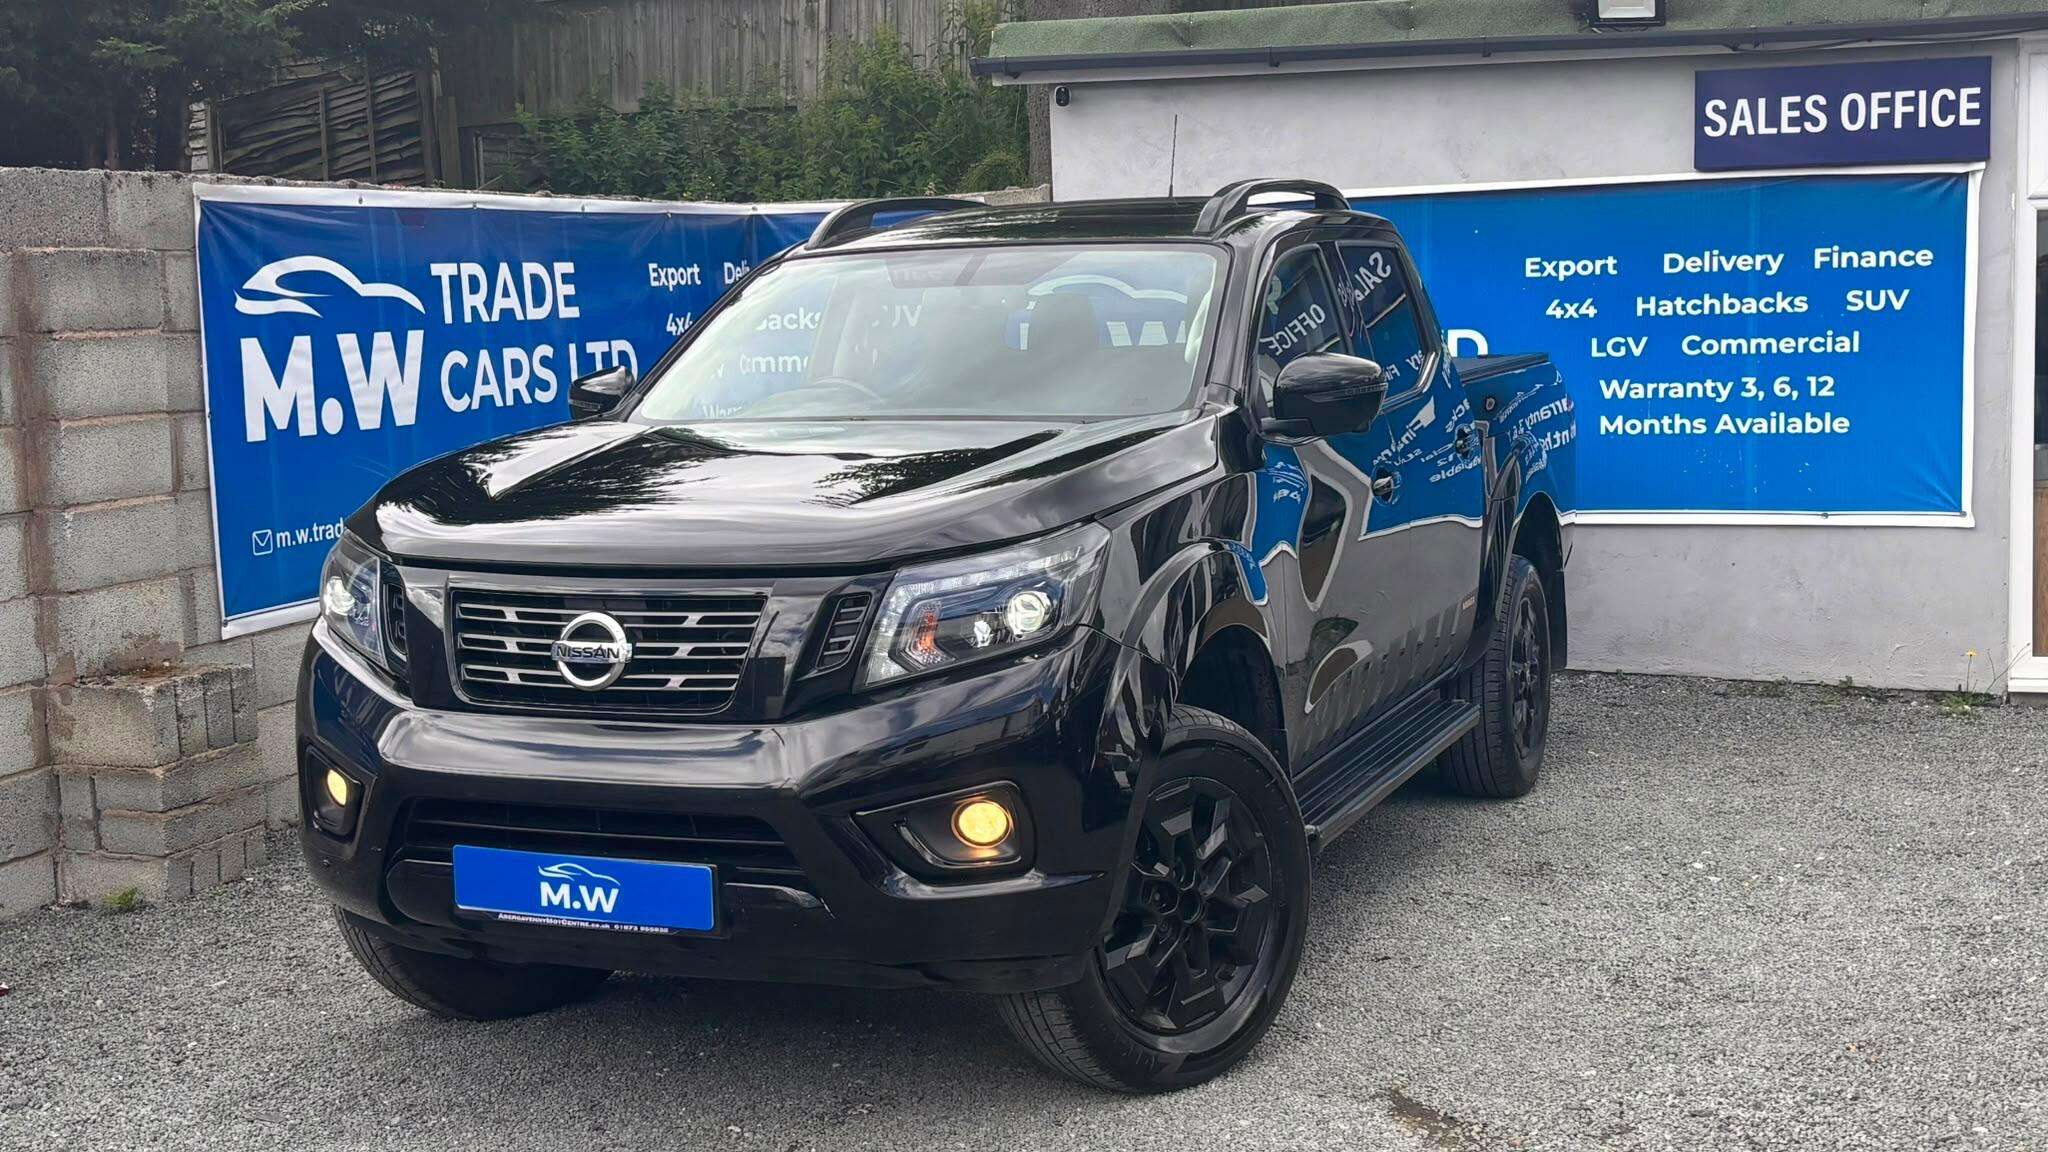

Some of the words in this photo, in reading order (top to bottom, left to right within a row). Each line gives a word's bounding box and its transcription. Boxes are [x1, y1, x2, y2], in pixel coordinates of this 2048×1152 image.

[1703, 94, 1828, 137] SALES
[1840, 87, 1981, 131] OFFICE
[648, 263, 702, 292] Export
[1526, 256, 1617, 281] Export
[1663, 250, 1784, 275] Delivery
[1814, 246, 1934, 269] Finance
[430, 262, 580, 324] TRADE
[1545, 298, 1598, 319] 4x4
[1636, 292, 1809, 317] Hatchbacks
[1846, 289, 1910, 312] SUV
[1591, 336, 1648, 357] LGV
[1682, 331, 1859, 356] Commercial
[240, 330, 424, 442] M.W
[440, 344, 558, 412] CARS
[1599, 379, 1733, 403] Warranty
[1741, 378, 1765, 400] 3,
[1773, 377, 1798, 400] 6,
[1807, 376, 1835, 396] 12
[1600, 413, 1707, 435] Months
[1715, 411, 1850, 434] Available
[556, 643, 620, 659] NISSAN
[540, 882, 619, 914] M.W
